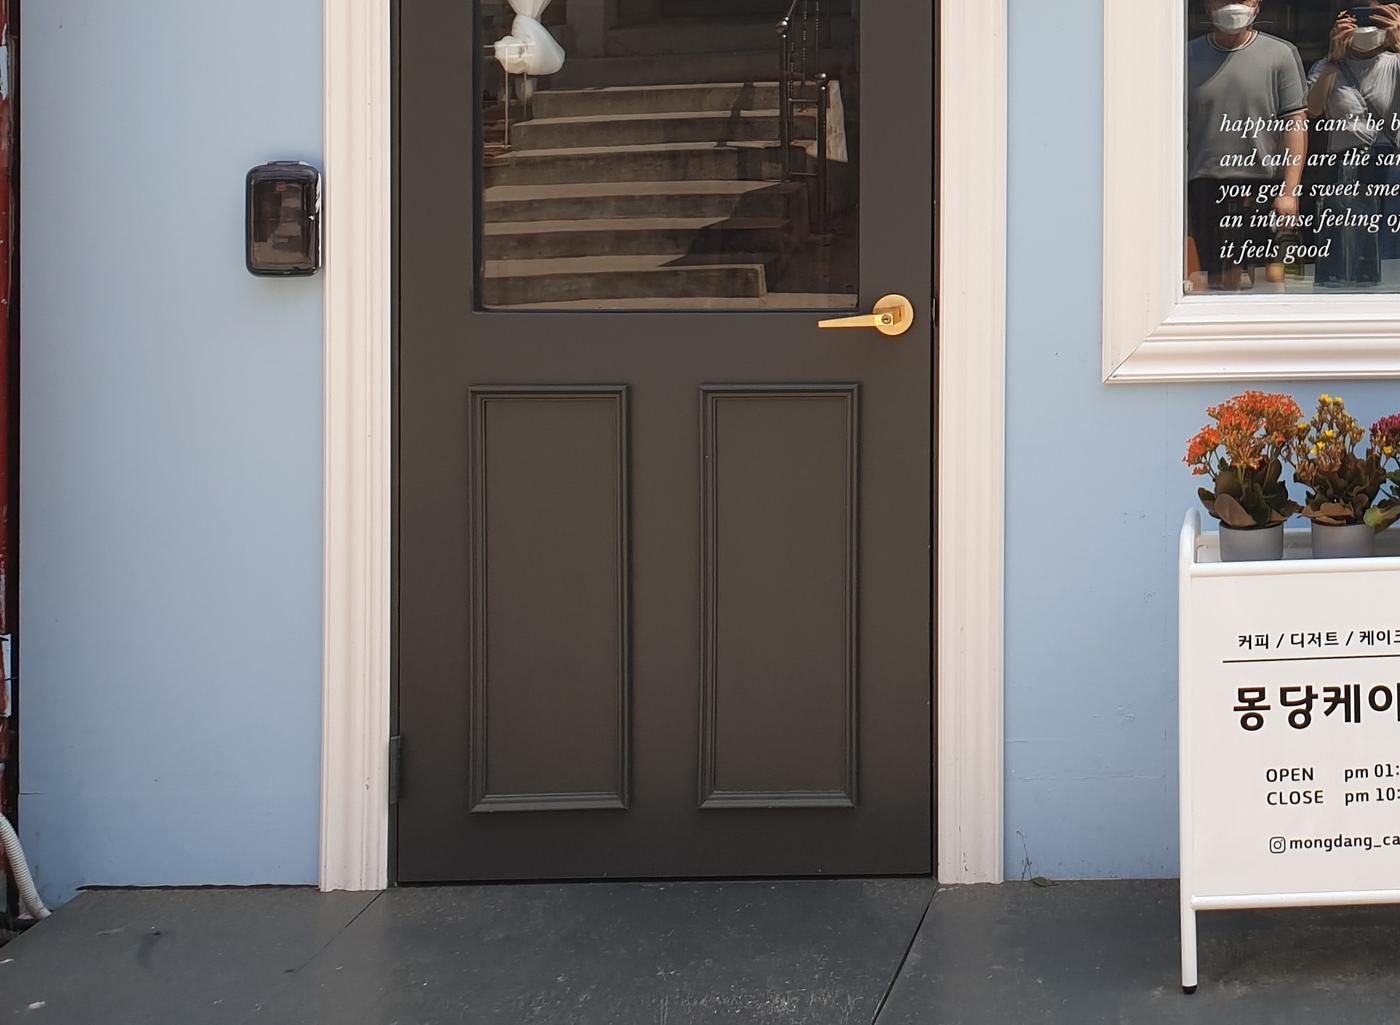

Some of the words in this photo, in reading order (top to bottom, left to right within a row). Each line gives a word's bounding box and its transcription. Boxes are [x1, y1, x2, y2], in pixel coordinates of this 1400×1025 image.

[1219, 113, 1310, 138] happiness
[1314, 113, 1360, 132] can't
[1366, 113, 1384, 132] be
[1219, 147, 1256, 167] and
[1261, 147, 1302, 167] cake
[1307, 151, 1337, 167] are
[1342, 147, 1370, 167] the
[1215, 182, 1252, 204] you
[1256, 178, 1286, 204] get
[1291, 182, 1304, 197] a
[1309, 179, 1360, 197] sweet
[1219, 213, 1243, 228] an
[1249, 210, 1313, 228] intense
[1313, 208, 1382, 233] feeling
[1219, 240, 1234, 259] it
[1234, 239, 1278, 264] feels
[1285, 239, 1332, 264] good
[1237, 632, 1270, 650] 커피
[1276, 633, 1285, 649] /
[1290, 631, 1340, 648] 디저트
[1345, 631, 1354, 646] /
[1265, 767, 1314, 783] OPEN
[1344, 767, 1369, 782] pm
[1266, 789, 1324, 806] CLOSE
[1344, 791, 1370, 806] pm
